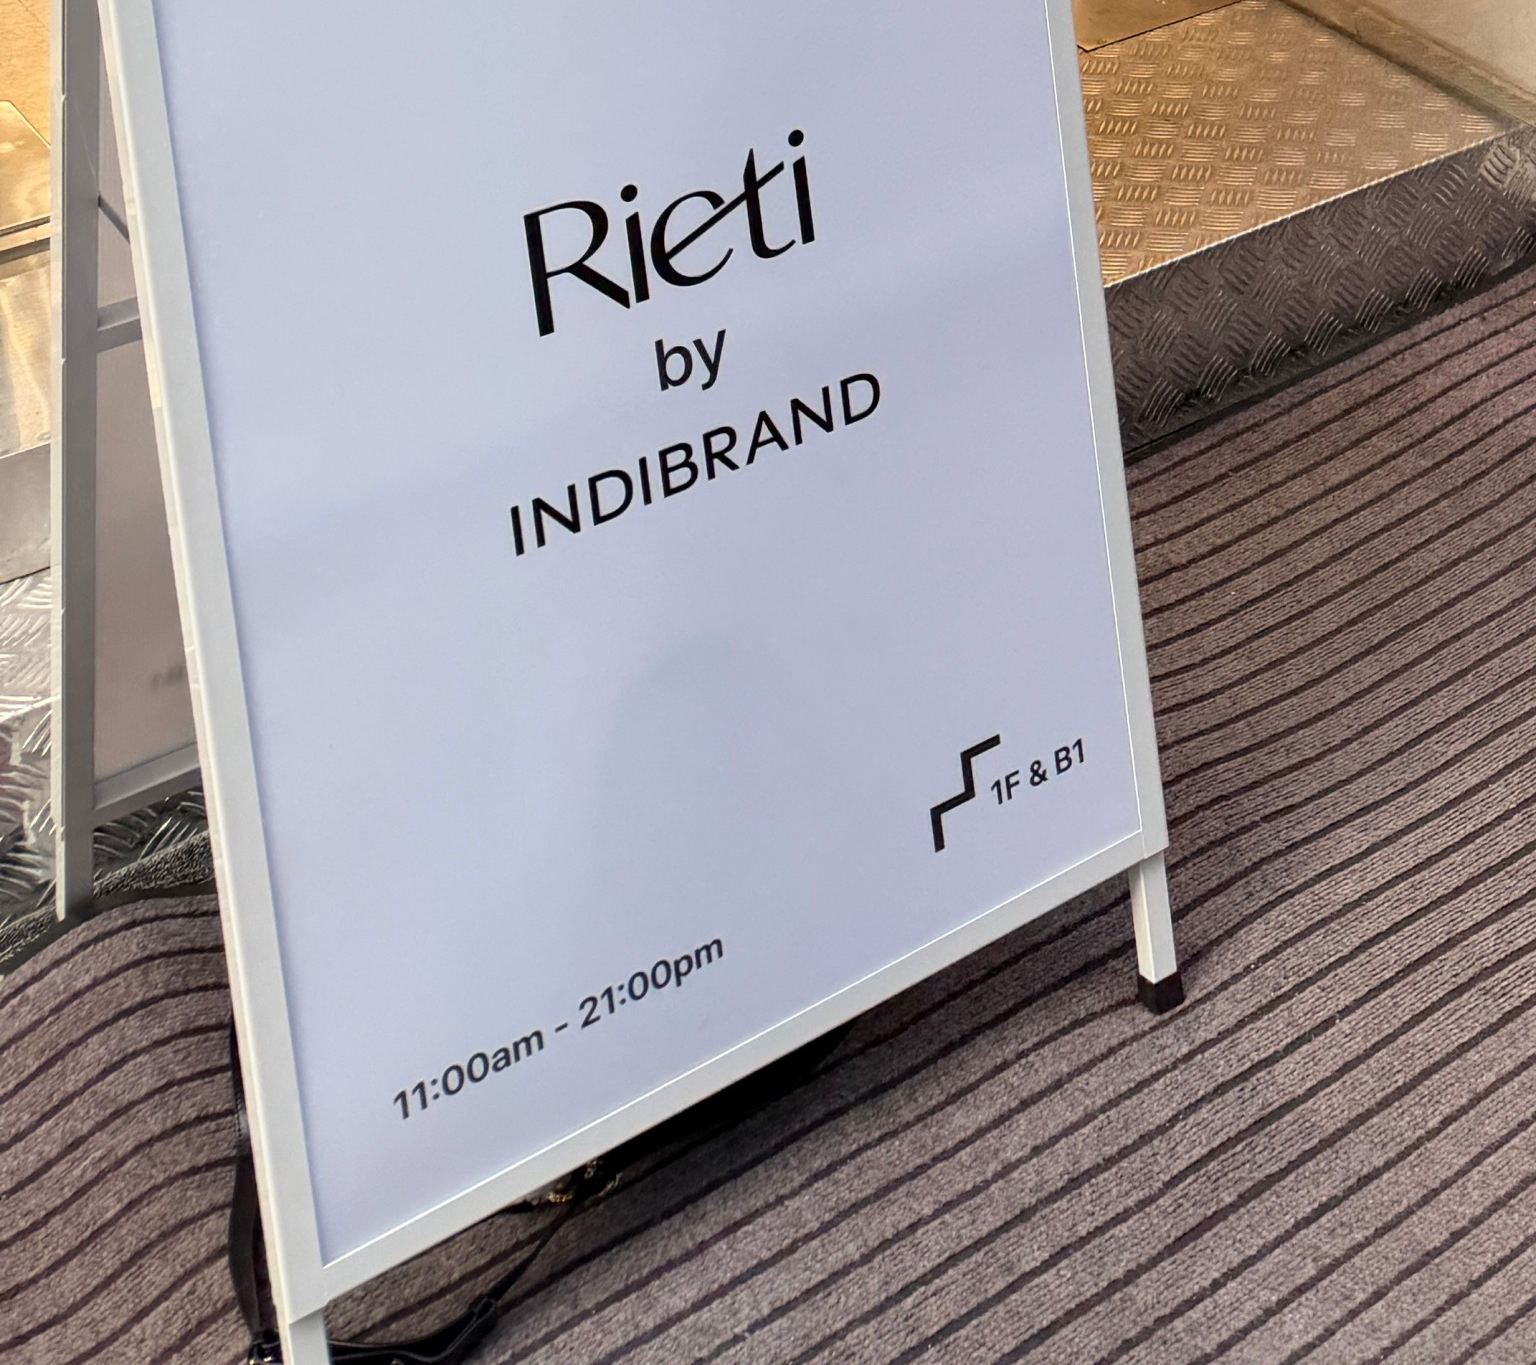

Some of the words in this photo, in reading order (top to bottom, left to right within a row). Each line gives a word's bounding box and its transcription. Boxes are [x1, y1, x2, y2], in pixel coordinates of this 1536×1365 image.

[524, 130, 815, 338] Rieti
[655, 329, 726, 391] by
[511, 372, 880, 556] INDIBRAND
[990, 771, 1022, 805] 1F
[1030, 760, 1048, 786] &
[1055, 739, 1087, 775] B1
[394, 1031, 544, 1119] 11:00am
[555, 1023, 568, 1032] -
[579, 939, 723, 1028] 21:00pm
